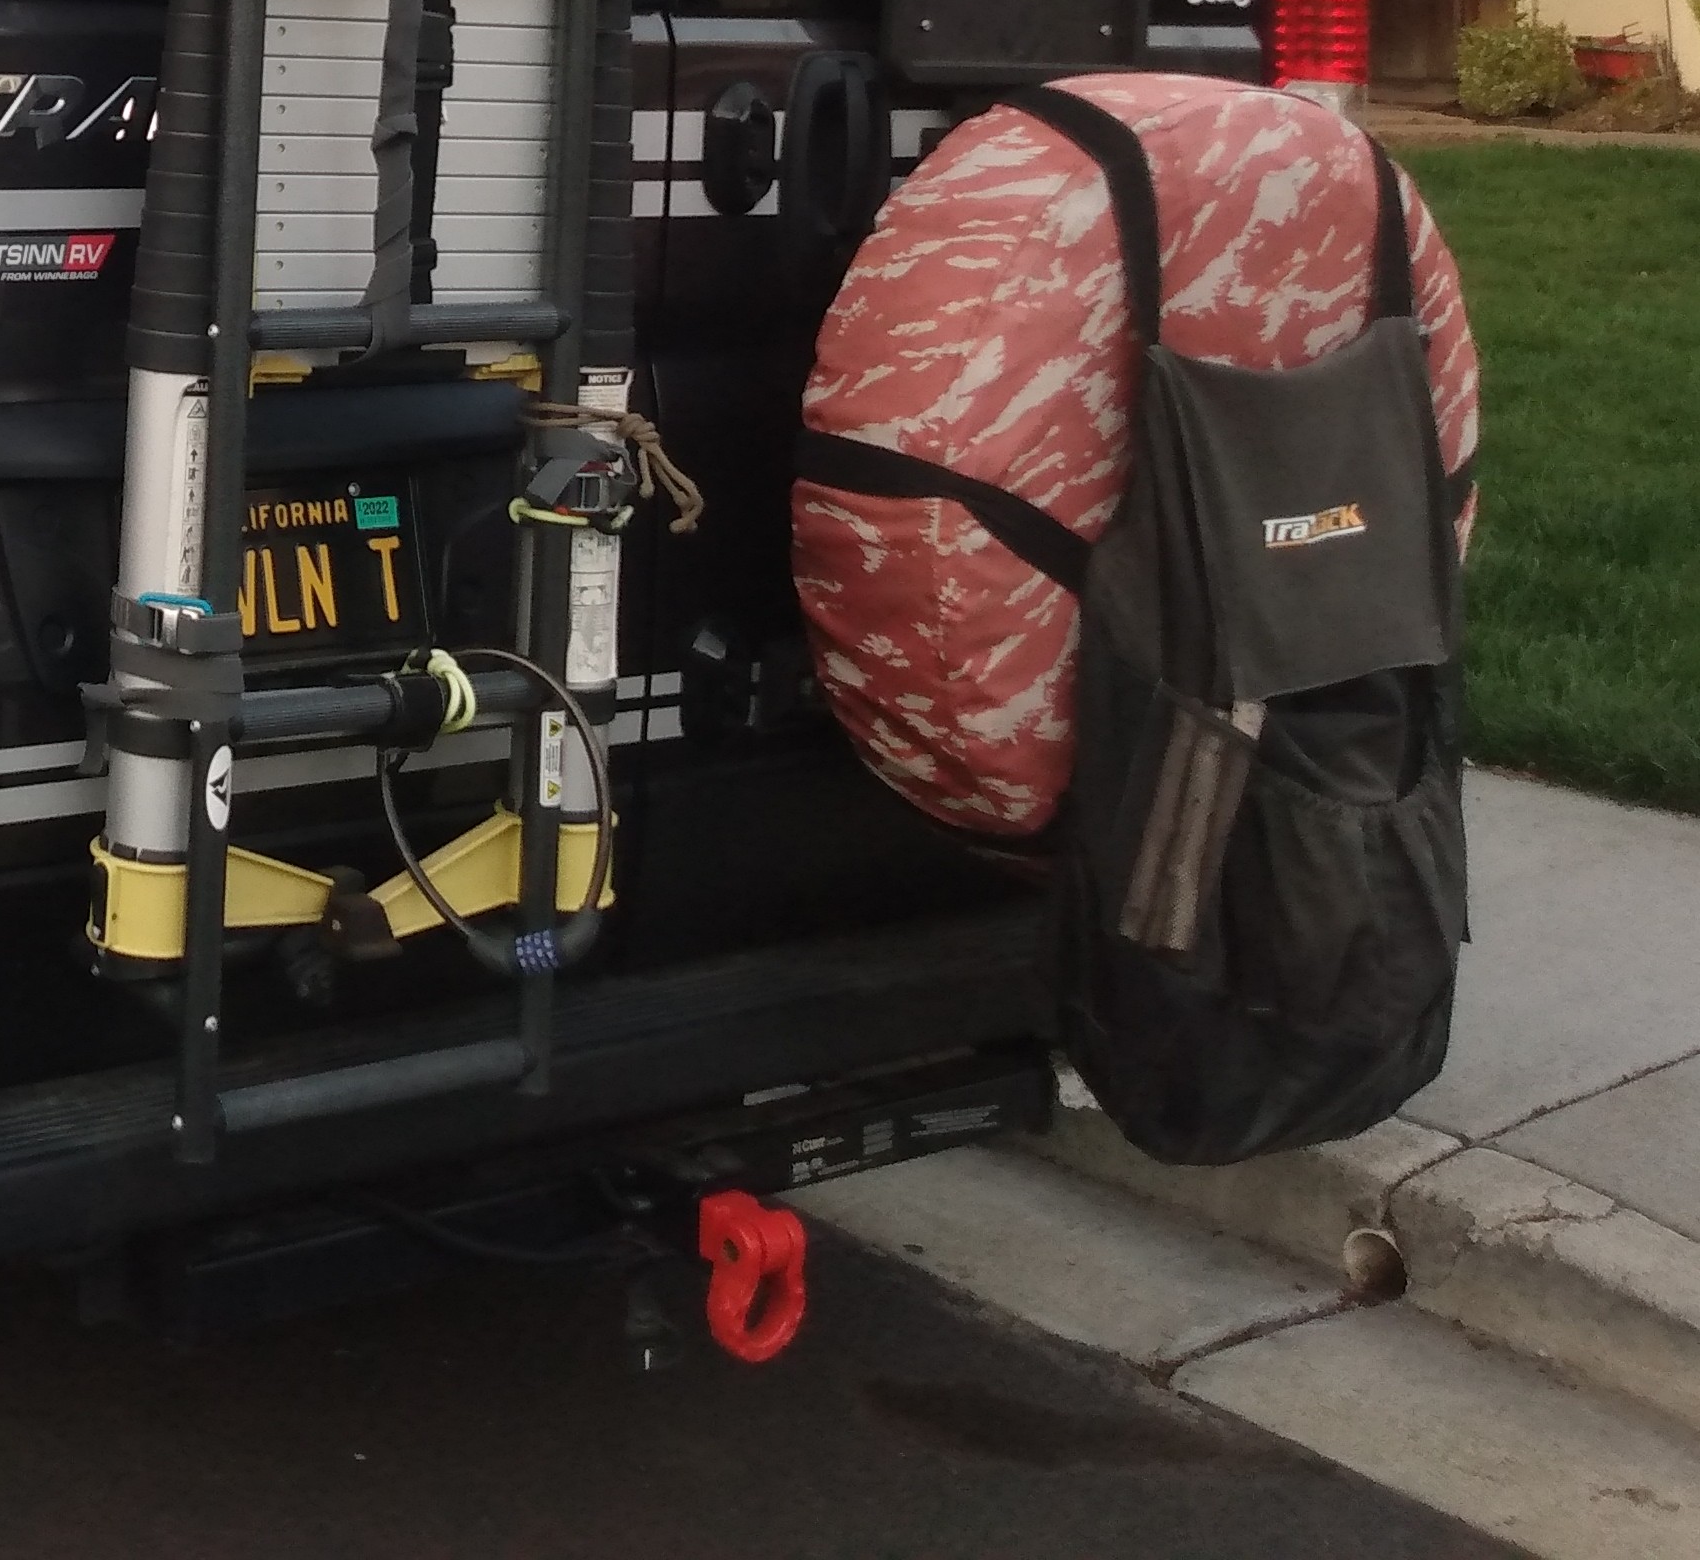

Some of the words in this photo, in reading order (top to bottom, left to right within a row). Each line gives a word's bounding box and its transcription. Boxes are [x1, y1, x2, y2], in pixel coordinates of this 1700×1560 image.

[69, 244, 105, 265] RV
[0, 271, 33, 282] FROM
[34, 270, 99, 282] WINNEBAGO
[587, 374, 623, 384] NOTICE
[242, 498, 350, 532] IFORNIA
[362, 500, 390, 515] 2022
[367, 535, 400, 622] T
